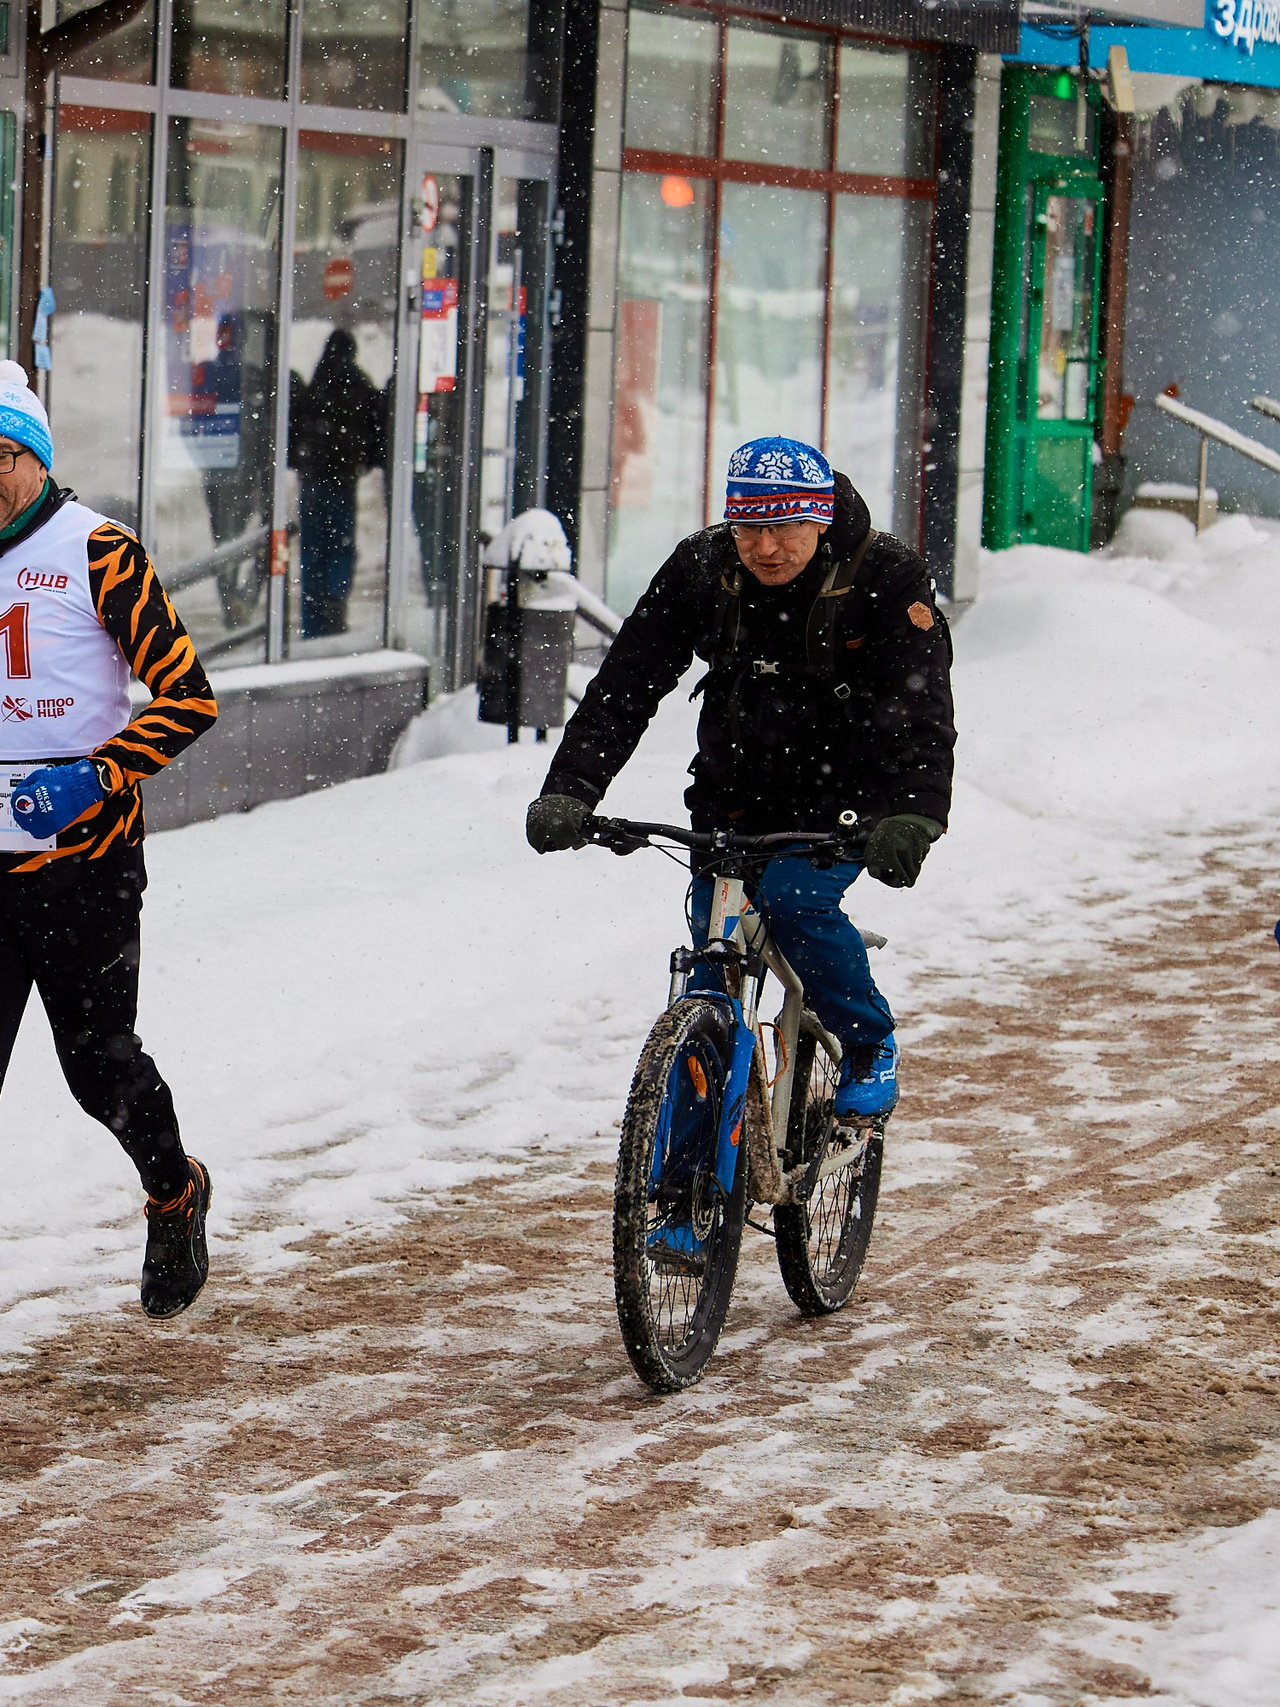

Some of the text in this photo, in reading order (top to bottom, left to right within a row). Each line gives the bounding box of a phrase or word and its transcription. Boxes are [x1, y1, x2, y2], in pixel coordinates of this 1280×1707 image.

[25, 572, 69, 589] НЦВ
[37, 697, 75, 709] ППОО
[37, 707, 66, 718] НЦВ
